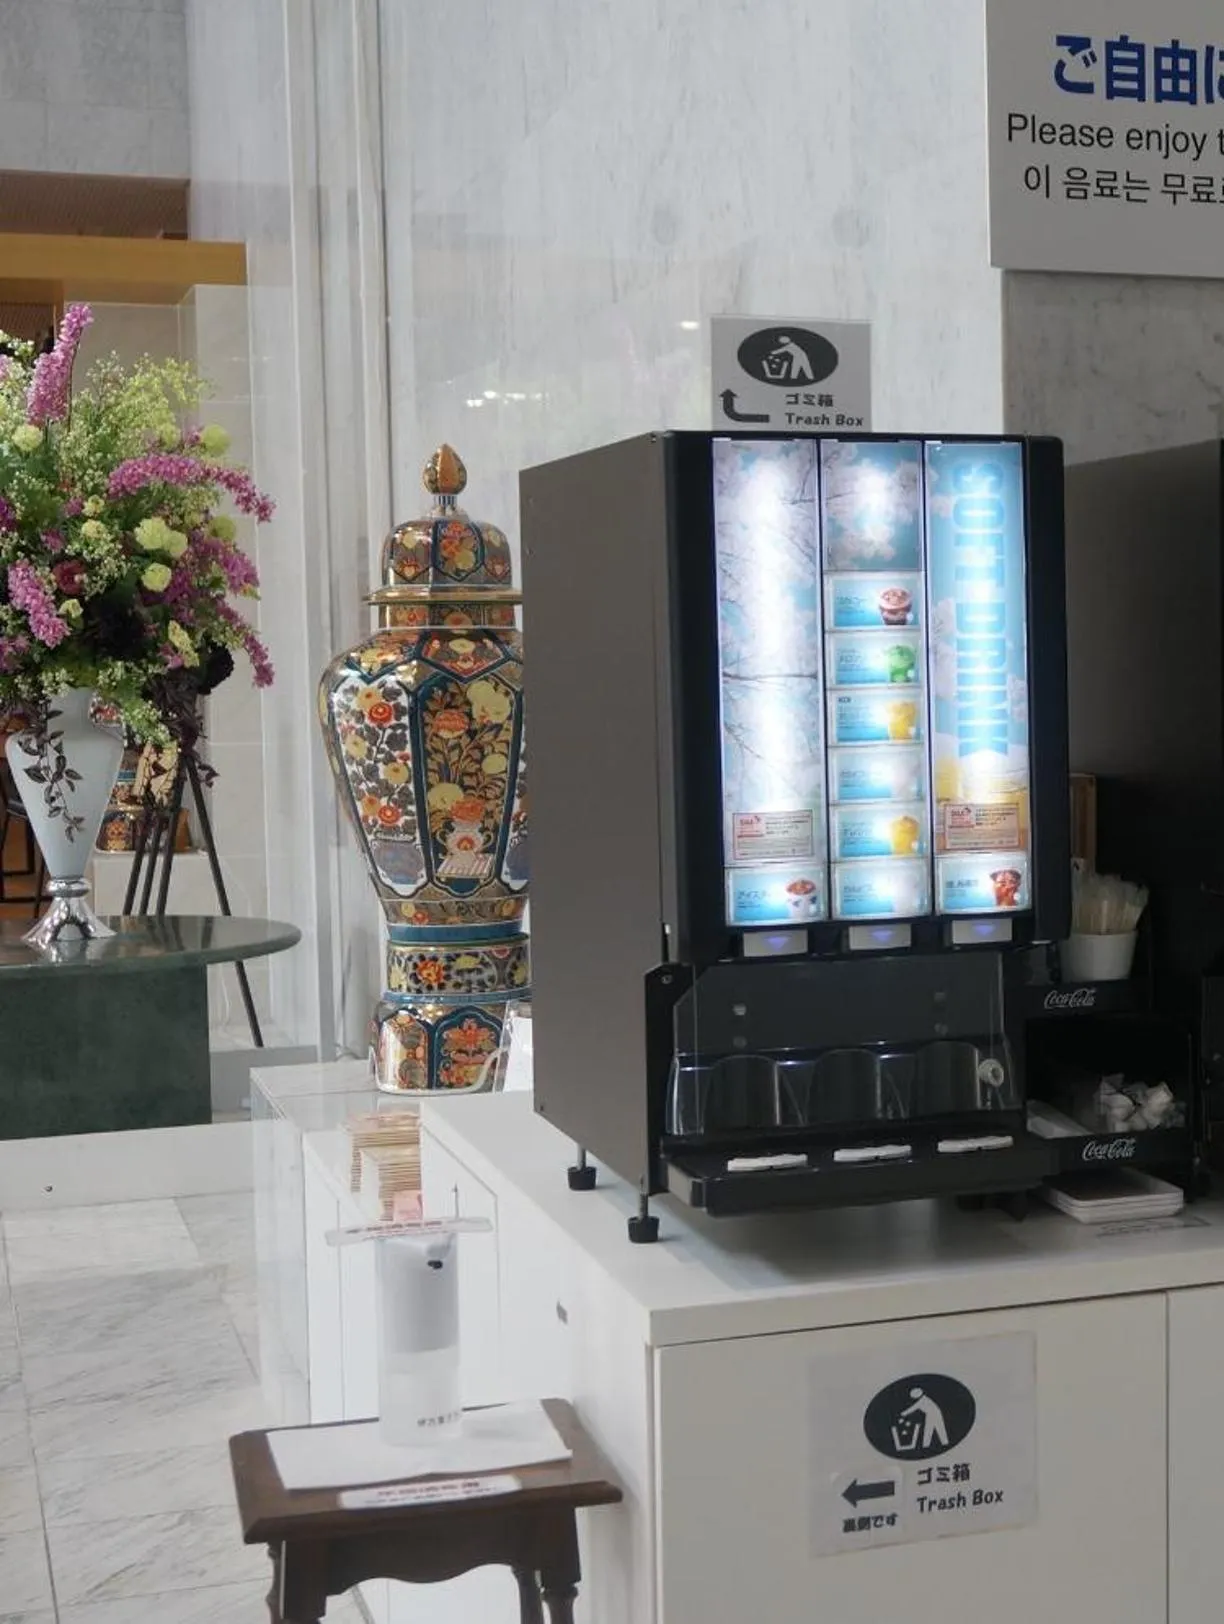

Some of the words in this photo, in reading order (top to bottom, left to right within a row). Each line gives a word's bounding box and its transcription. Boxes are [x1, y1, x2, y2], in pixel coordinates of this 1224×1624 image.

[1007, 113, 1114, 149] Please
[1125, 124, 1208, 162] enjoy
[1024, 164, 1050, 199] 이
[1063, 167, 1151, 203] 음료는
[786, 392, 834, 408] ゴミ箱
[785, 412, 830, 426] Trash
[835, 413, 864, 427] Box
[953, 461, 1006, 588] SOFT
[955, 601, 1009, 758] DRINK
[1044, 988, 1096, 1010] Coca-Cola
[1082, 1138, 1136, 1161] Coca-Cola
[917, 1463, 971, 1485] ゴミ箱
[916, 1491, 967, 1513] Trash
[972, 1489, 1004, 1506] Box
